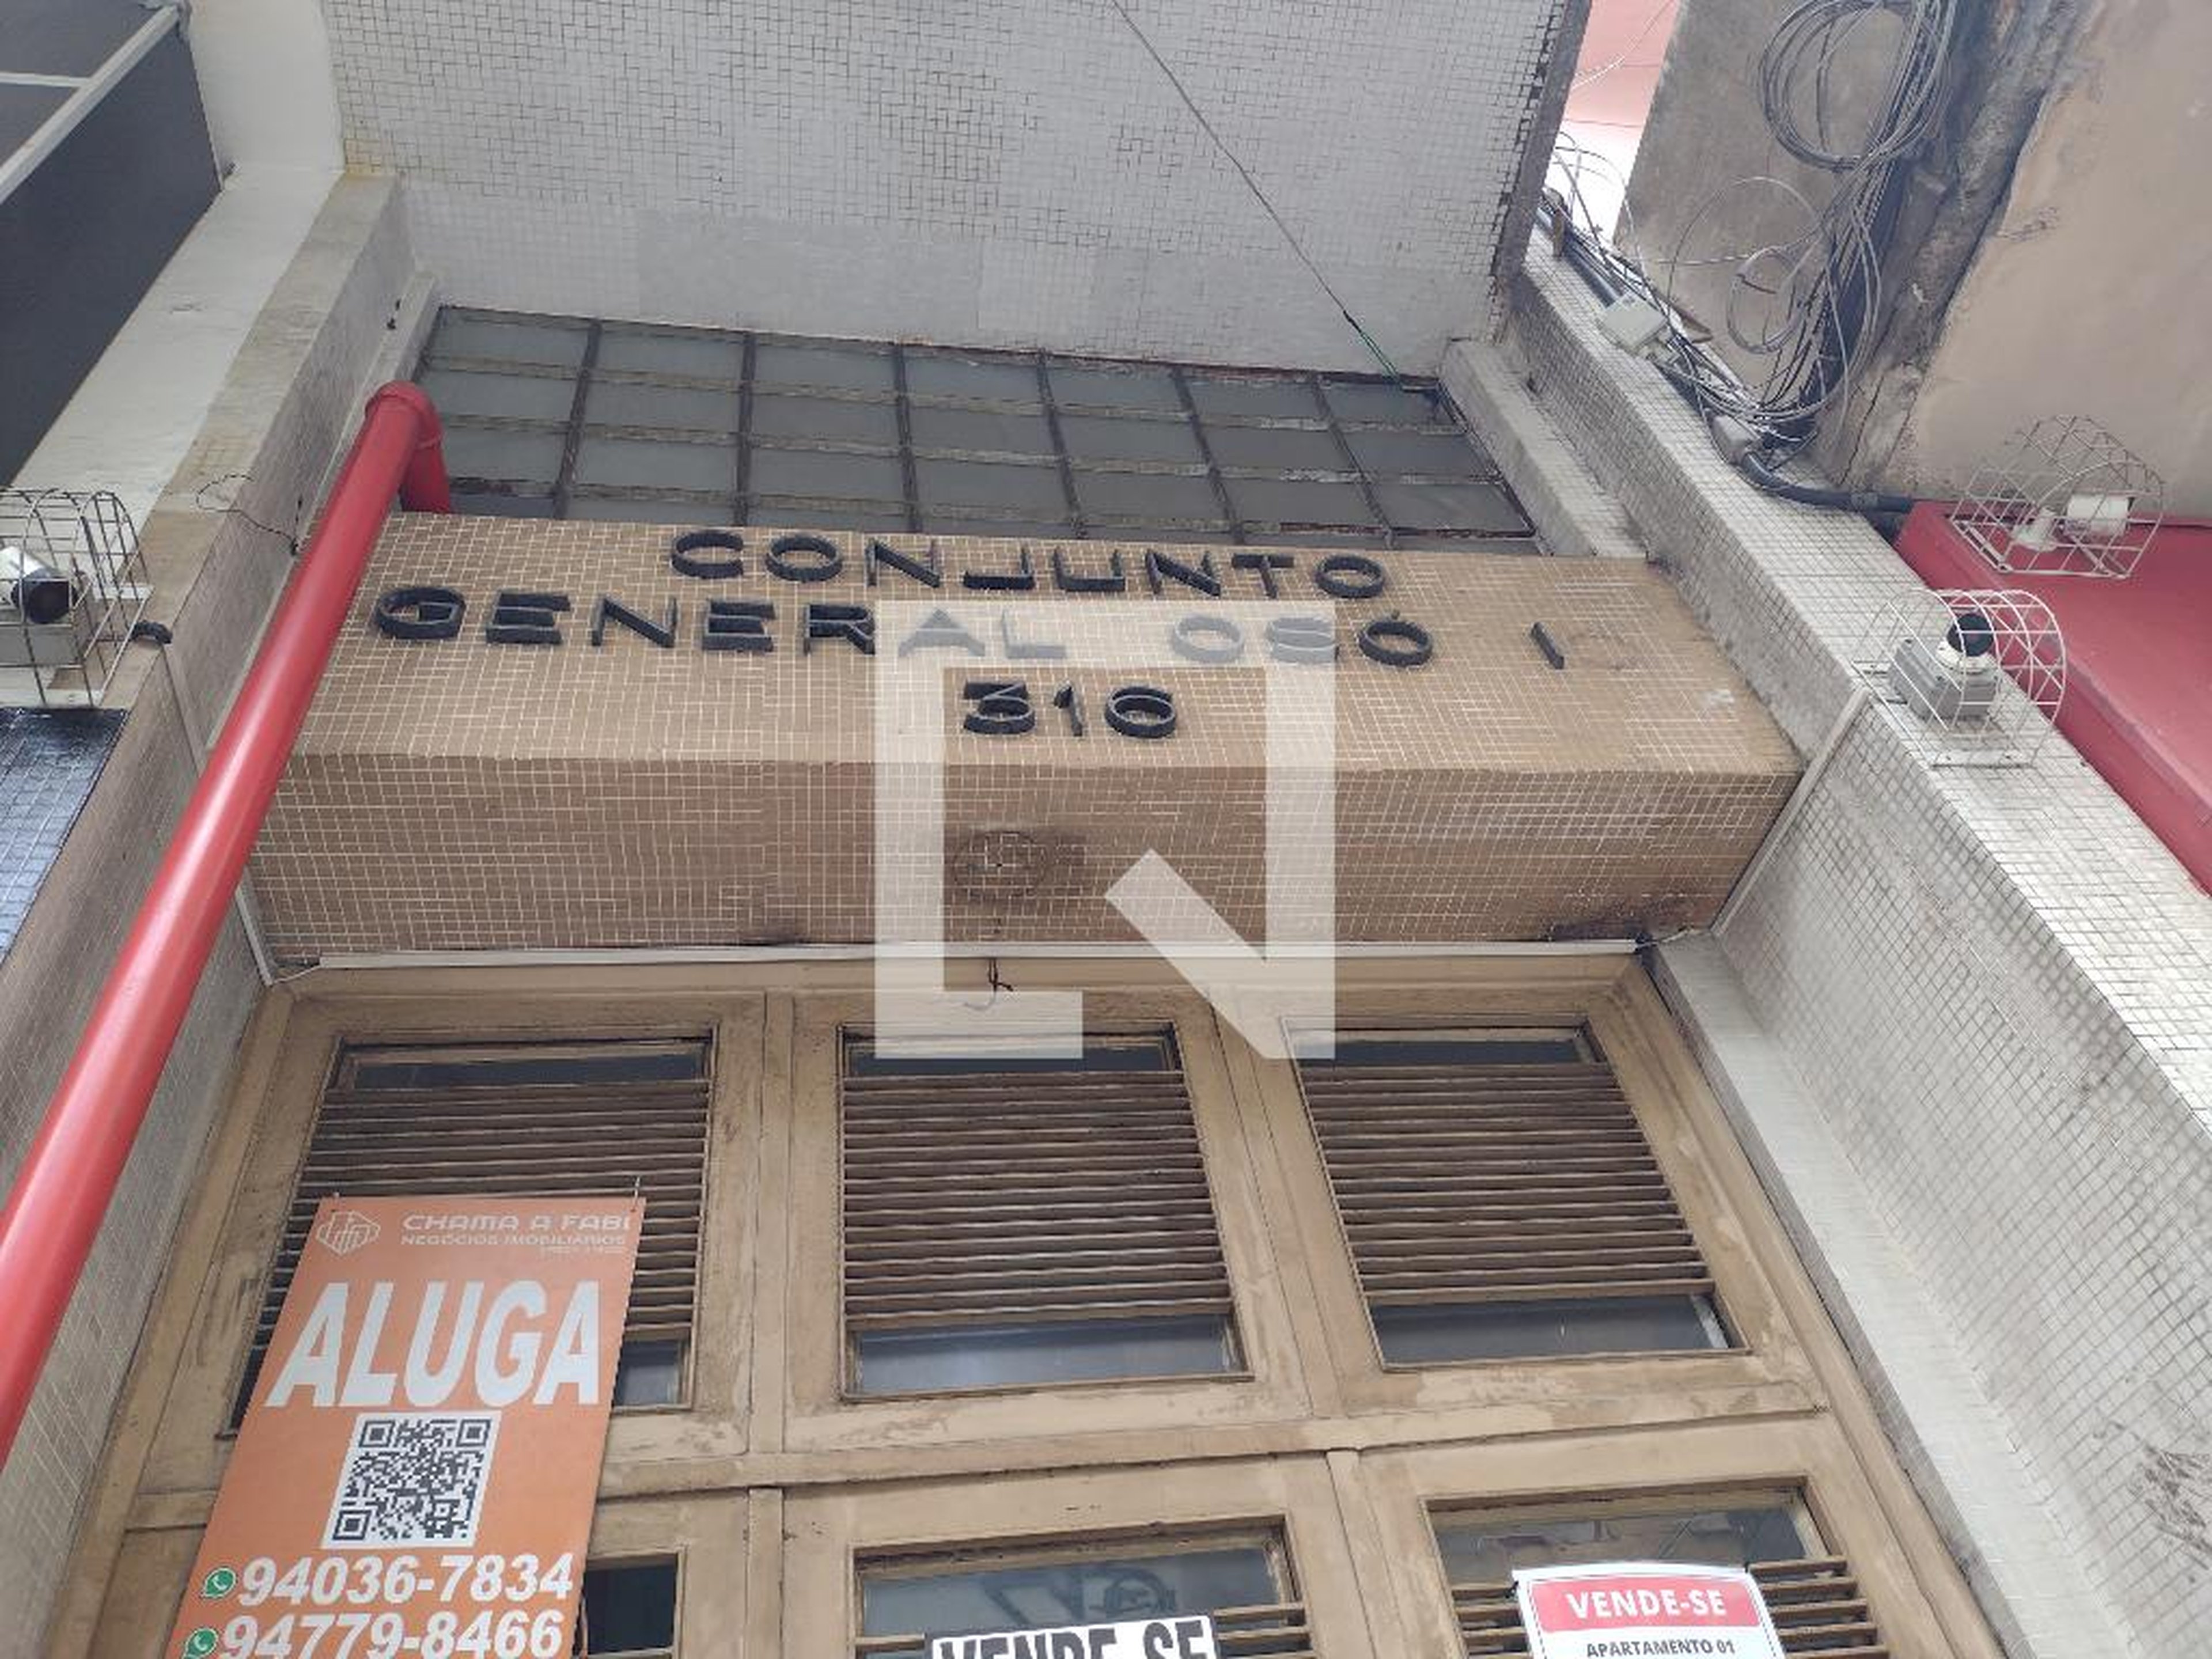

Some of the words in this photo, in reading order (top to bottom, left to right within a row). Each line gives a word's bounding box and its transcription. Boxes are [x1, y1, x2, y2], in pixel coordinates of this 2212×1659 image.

[671, 529, 1385, 599] CONJUNTO
[374, 585, 1067, 659] GENERAL
[963, 679, 1177, 738] 316
[403, 1214, 520, 1231] CHAMA
[529, 1215, 553, 1231] A
[264, 1279, 600, 1408] ALUGA
[238, 1552, 574, 1607] 94036-7834
[1565, 1588, 1728, 1619] VENDE-SE
[219, 1610, 565, 1659] 94779-8466
[1586, 1638, 1714, 1658] APARTAMENTO
[1716, 1639, 1736, 1654] 01
